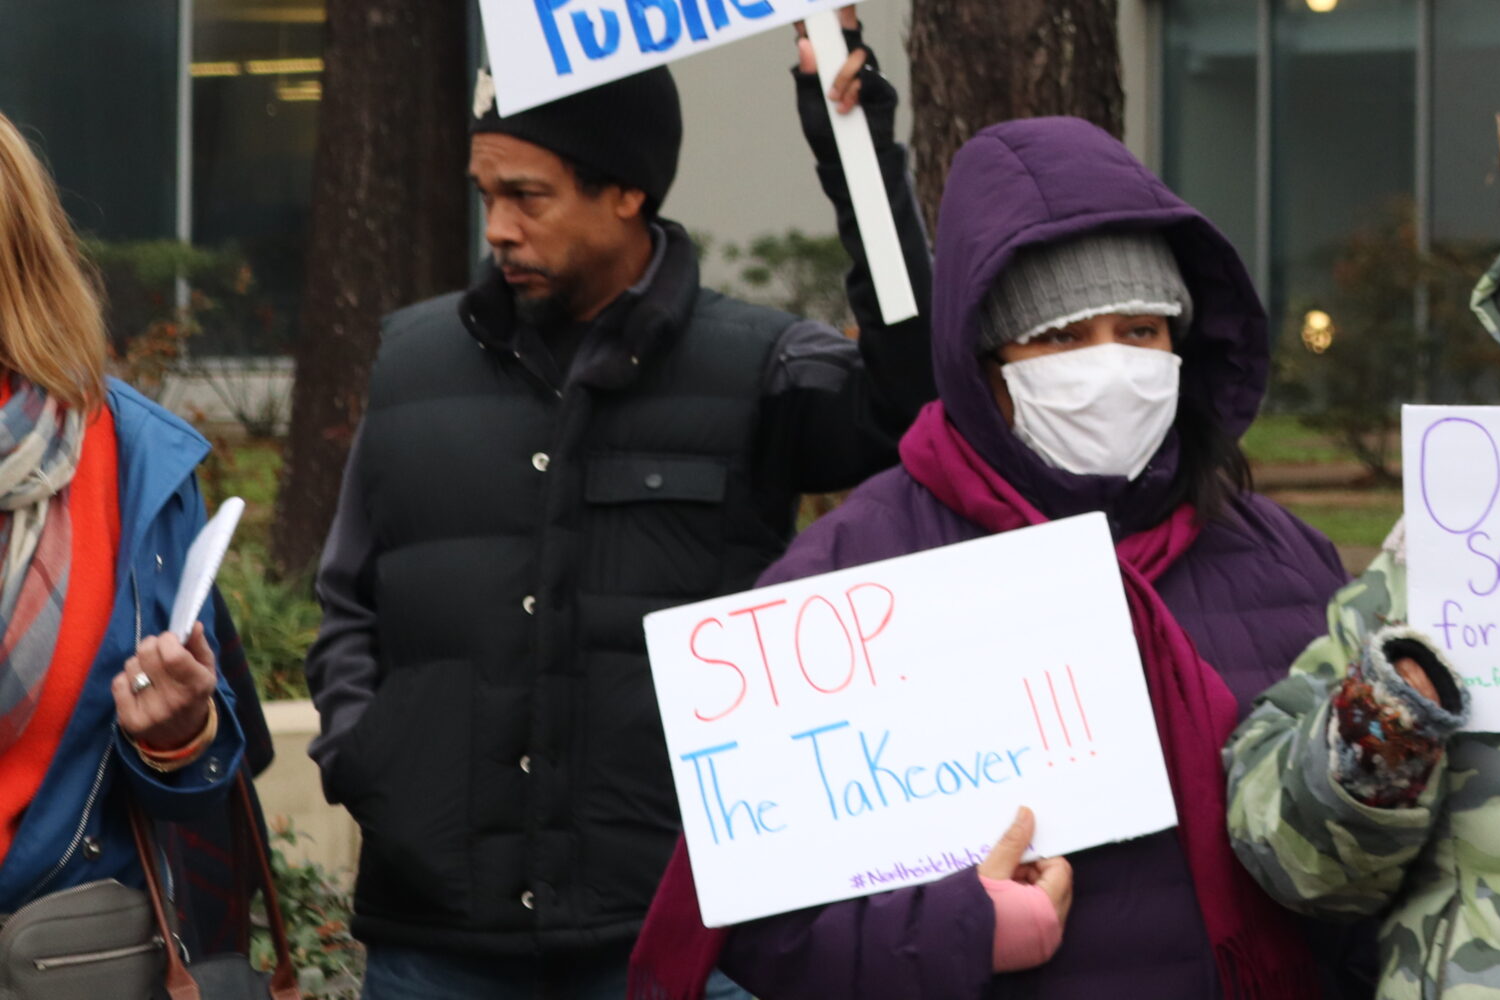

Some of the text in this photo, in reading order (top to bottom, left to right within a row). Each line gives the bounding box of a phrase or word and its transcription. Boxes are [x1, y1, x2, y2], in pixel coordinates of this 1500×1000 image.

[690, 582, 907, 722] STOP.
[1433, 600, 1496, 649] for
[681, 741, 788, 845] The
